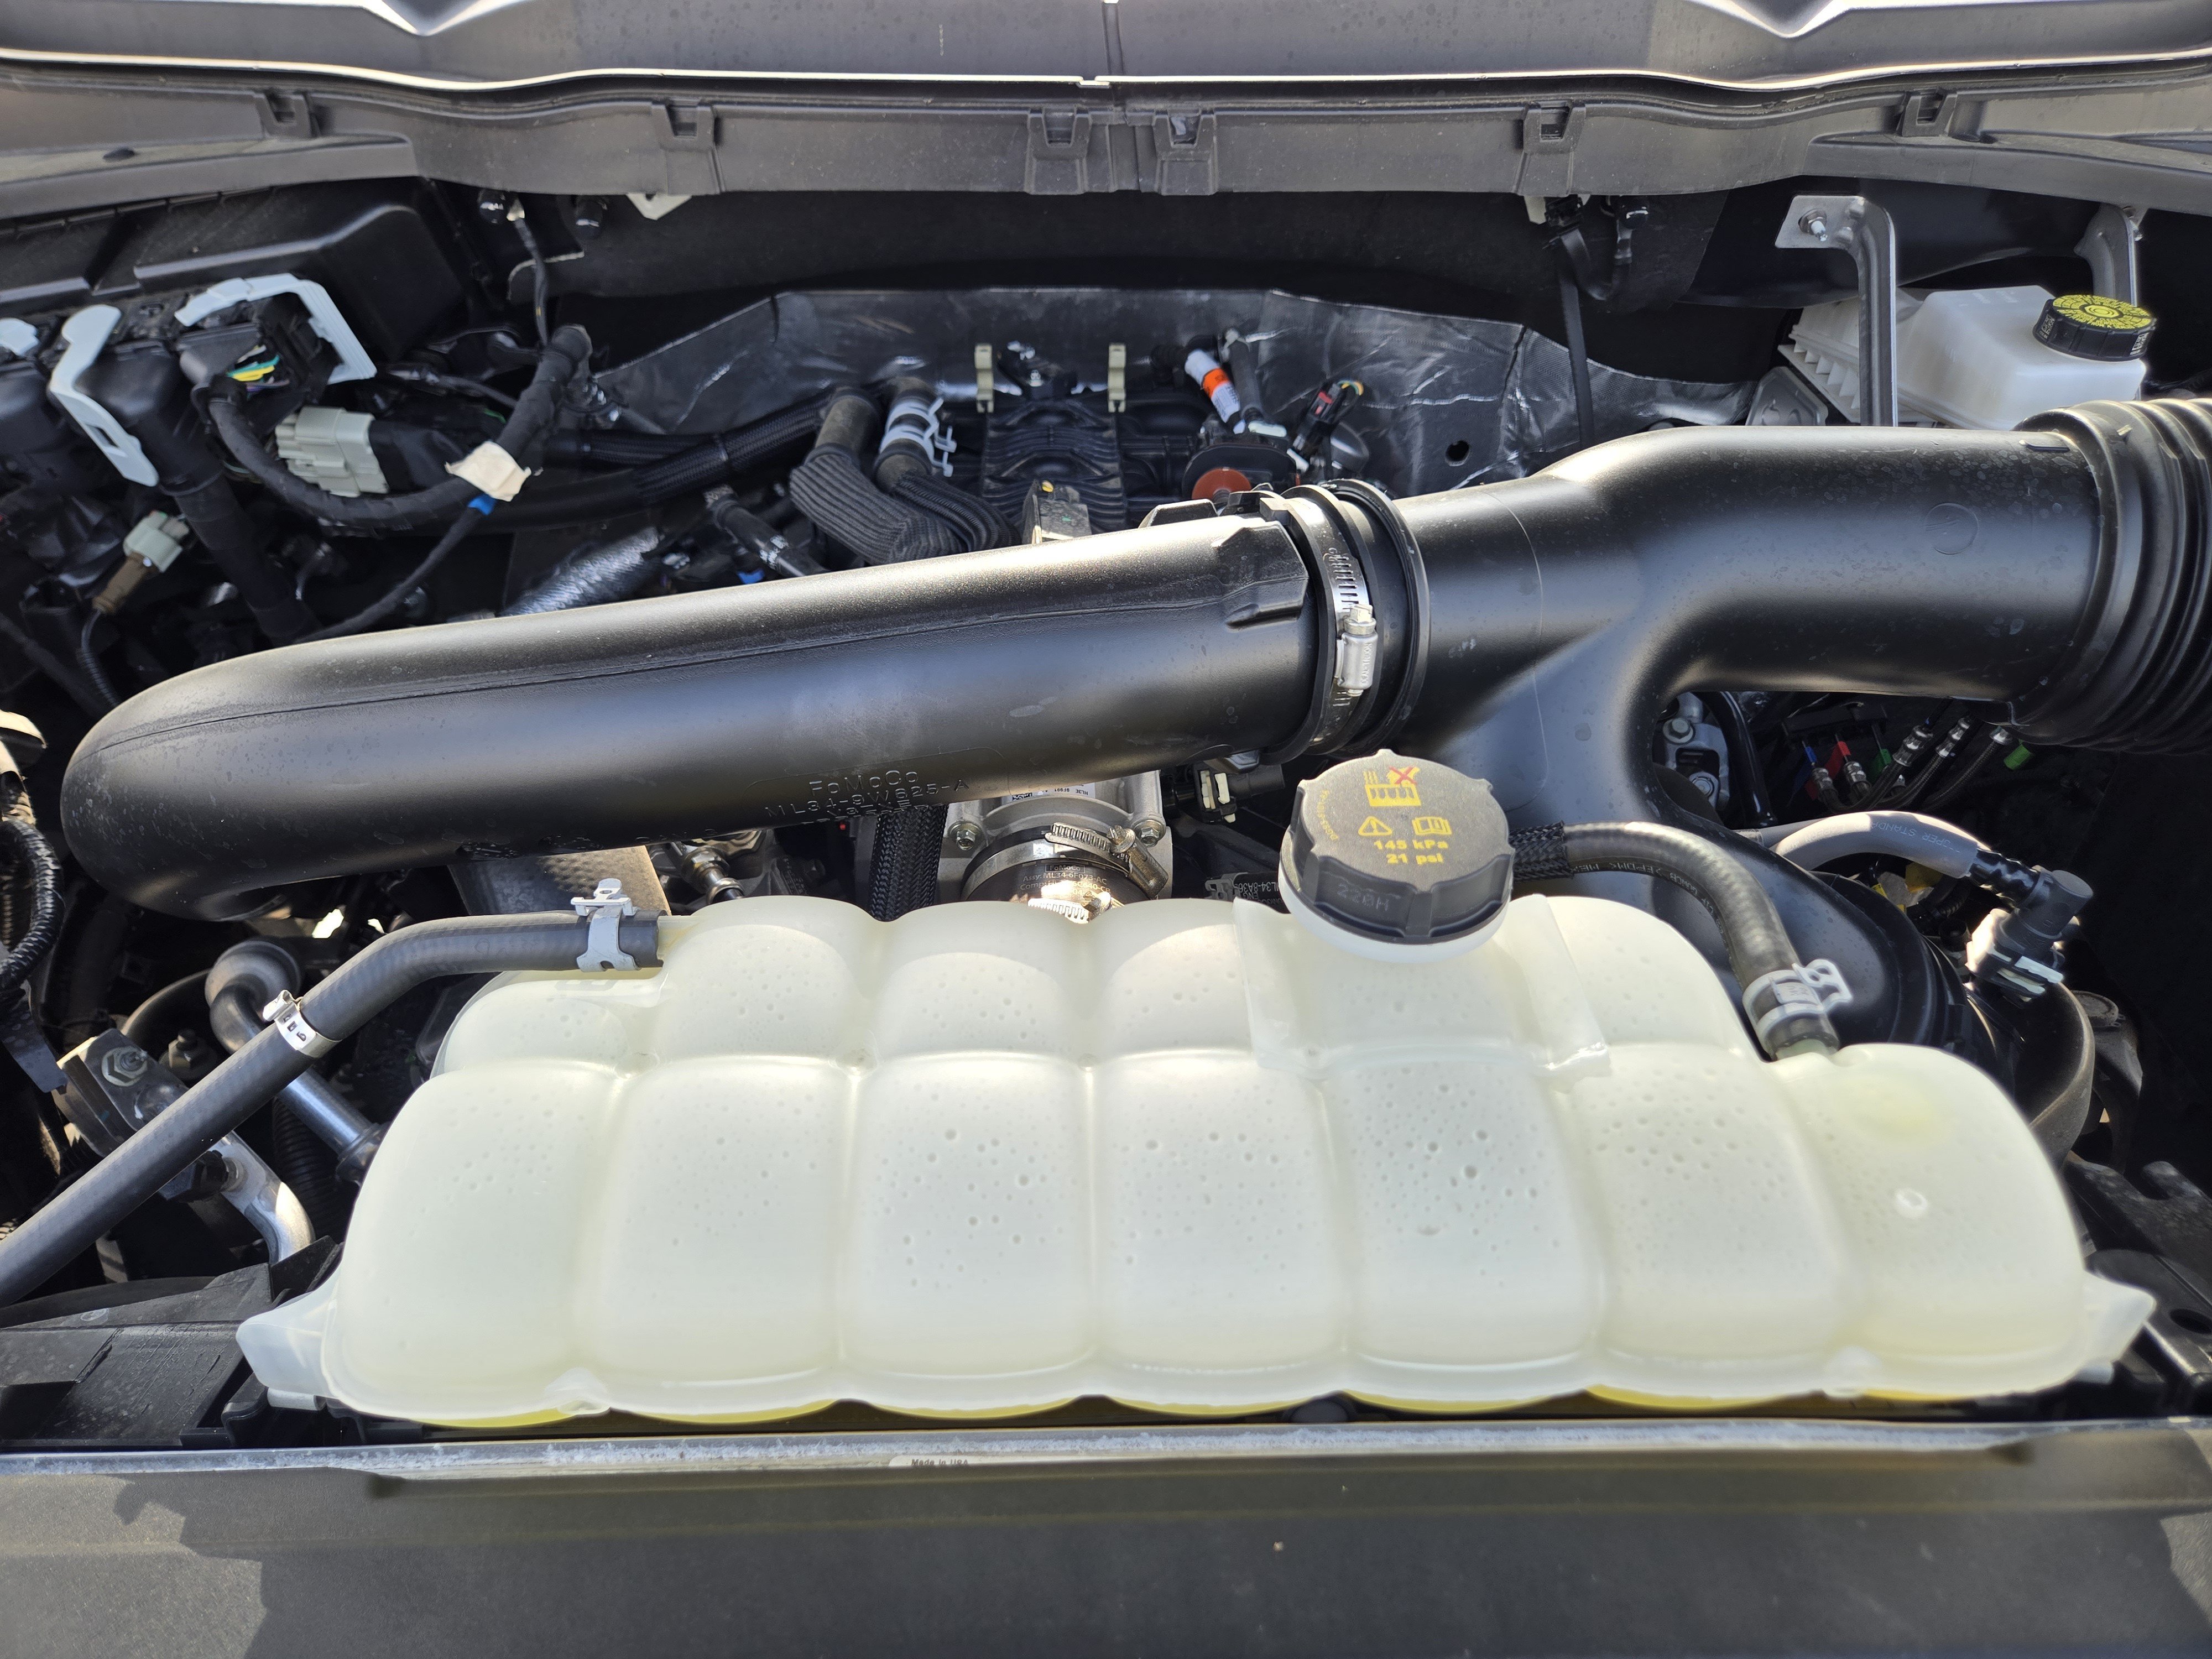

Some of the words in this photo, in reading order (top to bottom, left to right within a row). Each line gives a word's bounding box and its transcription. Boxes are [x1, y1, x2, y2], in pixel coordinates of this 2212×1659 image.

[1373, 840, 1406, 850] 145
[1412, 840, 1448, 849] kPa
[1387, 853, 1408, 863] 21
[1416, 853, 1443, 865] psi
